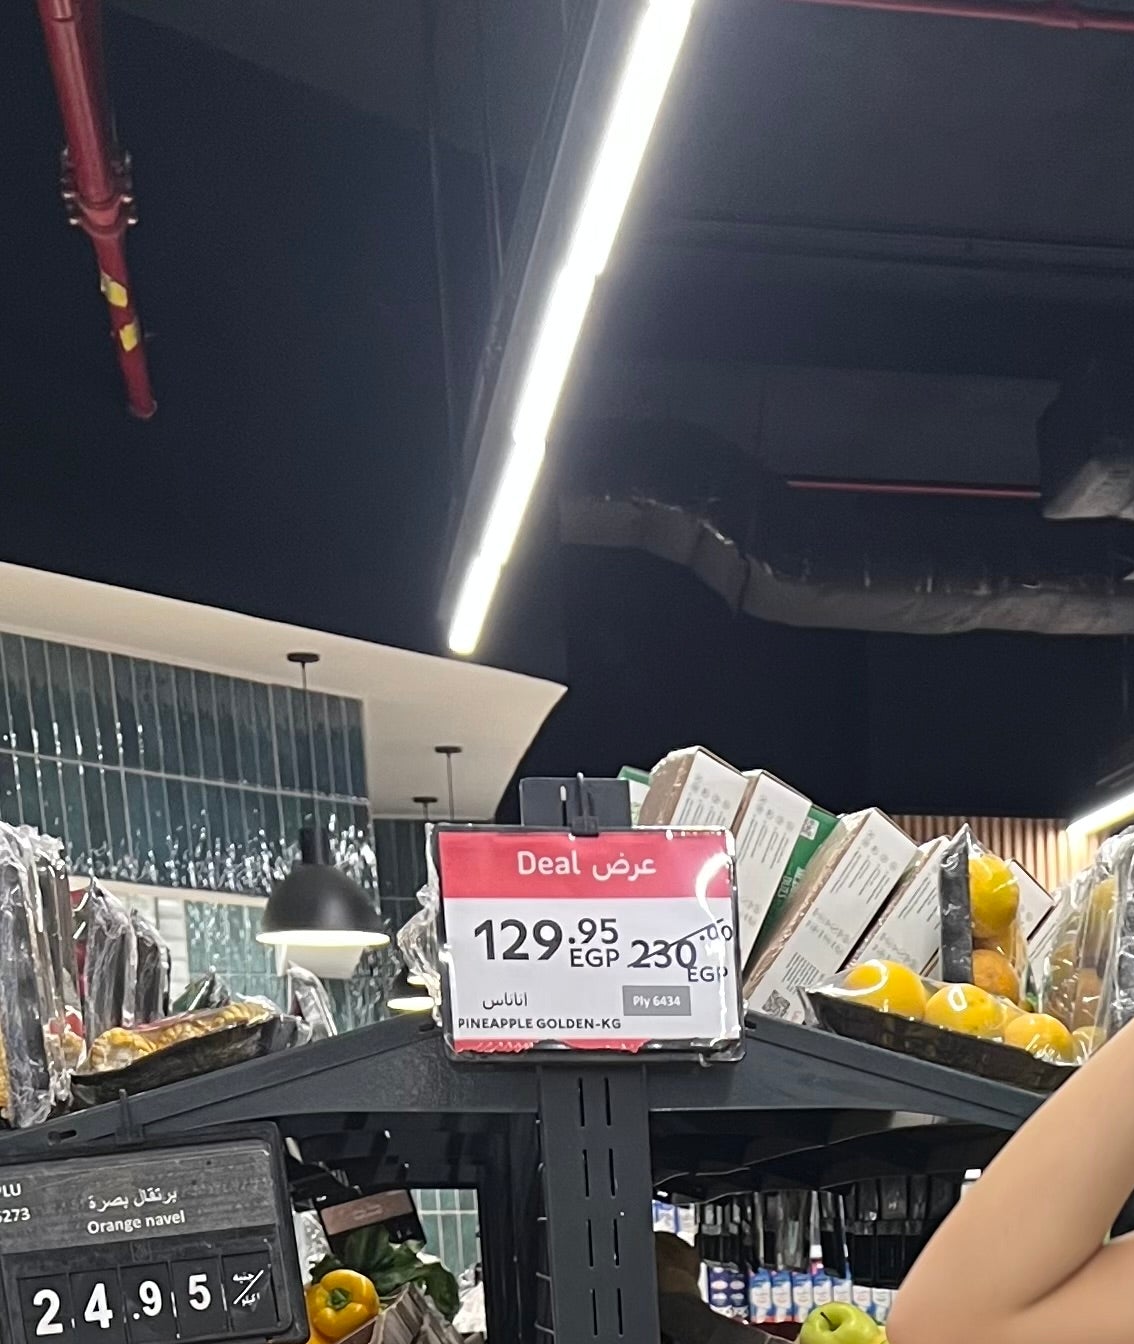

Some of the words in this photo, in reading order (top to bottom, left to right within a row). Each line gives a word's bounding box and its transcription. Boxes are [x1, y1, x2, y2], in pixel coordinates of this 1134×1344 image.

[517, 850, 581, 875] Deal
[592, 853, 657, 881] عرض
[570, 948, 620, 968] EGP
[688, 966, 728, 983] EGP
[653, 996, 681, 1007] 6434
[458, 1018, 534, 1030] PINEAPPLE
[536, 1018, 622, 1030] GOLDEN-KG
[0, 1183, 22, 1198] LU
[133, 1187, 177, 1208] برتقال
[87, 1215, 142, 1235] Orange
[145, 1210, 186, 1228] navel
